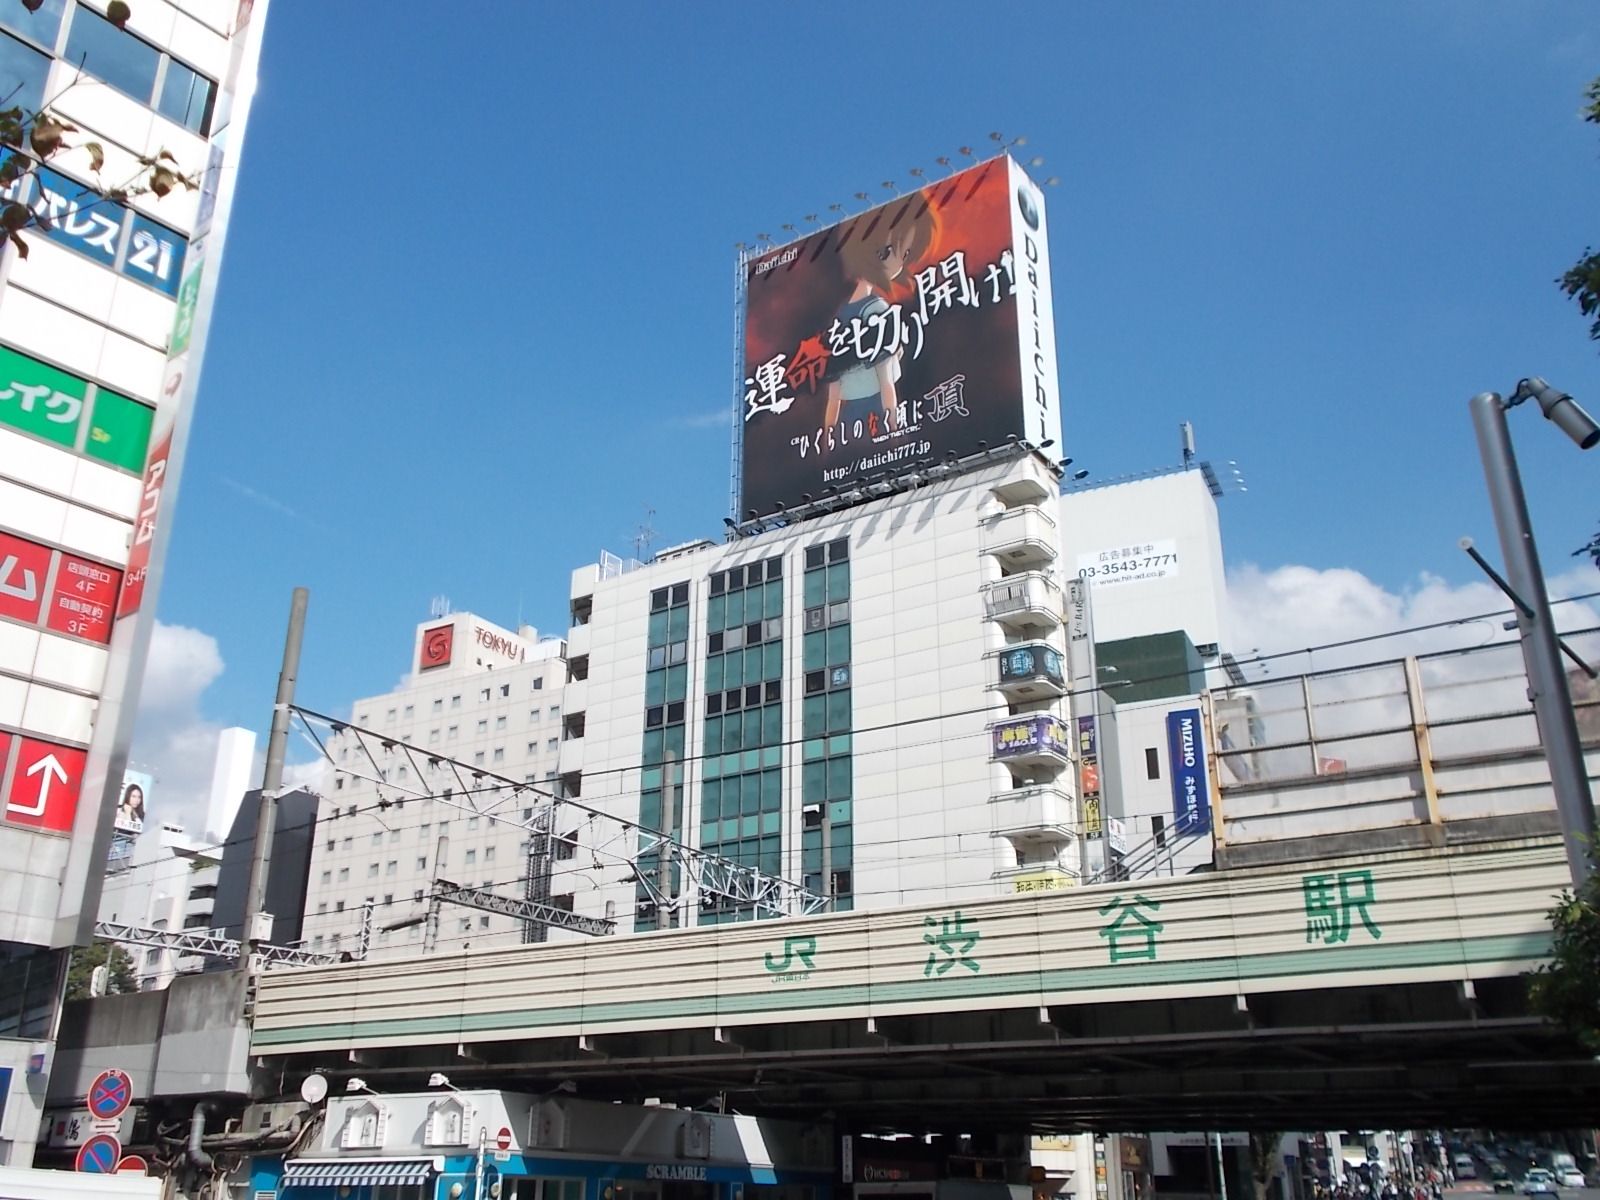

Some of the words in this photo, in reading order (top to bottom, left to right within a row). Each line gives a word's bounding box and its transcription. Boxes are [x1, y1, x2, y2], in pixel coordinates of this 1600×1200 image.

[823, 440, 931, 482] http://daiichi777.jp
[135, 459, 166, 545] アコム
[1078, 553, 1177, 578] 03-3543-7771
[1099, 544, 1154, 561] 広告募集中
[0, 554, 36, 601] ム
[75, 580, 97, 593] 4F
[59, 597, 104, 619] 自動契約
[67, 620, 88, 634] 3F
[474, 626, 518, 660] TOKYU
[1181, 718, 1196, 767] MIZUHO
[765, 935, 817, 972] JR
[646, 1165, 707, 1181] SCRAMBLE
